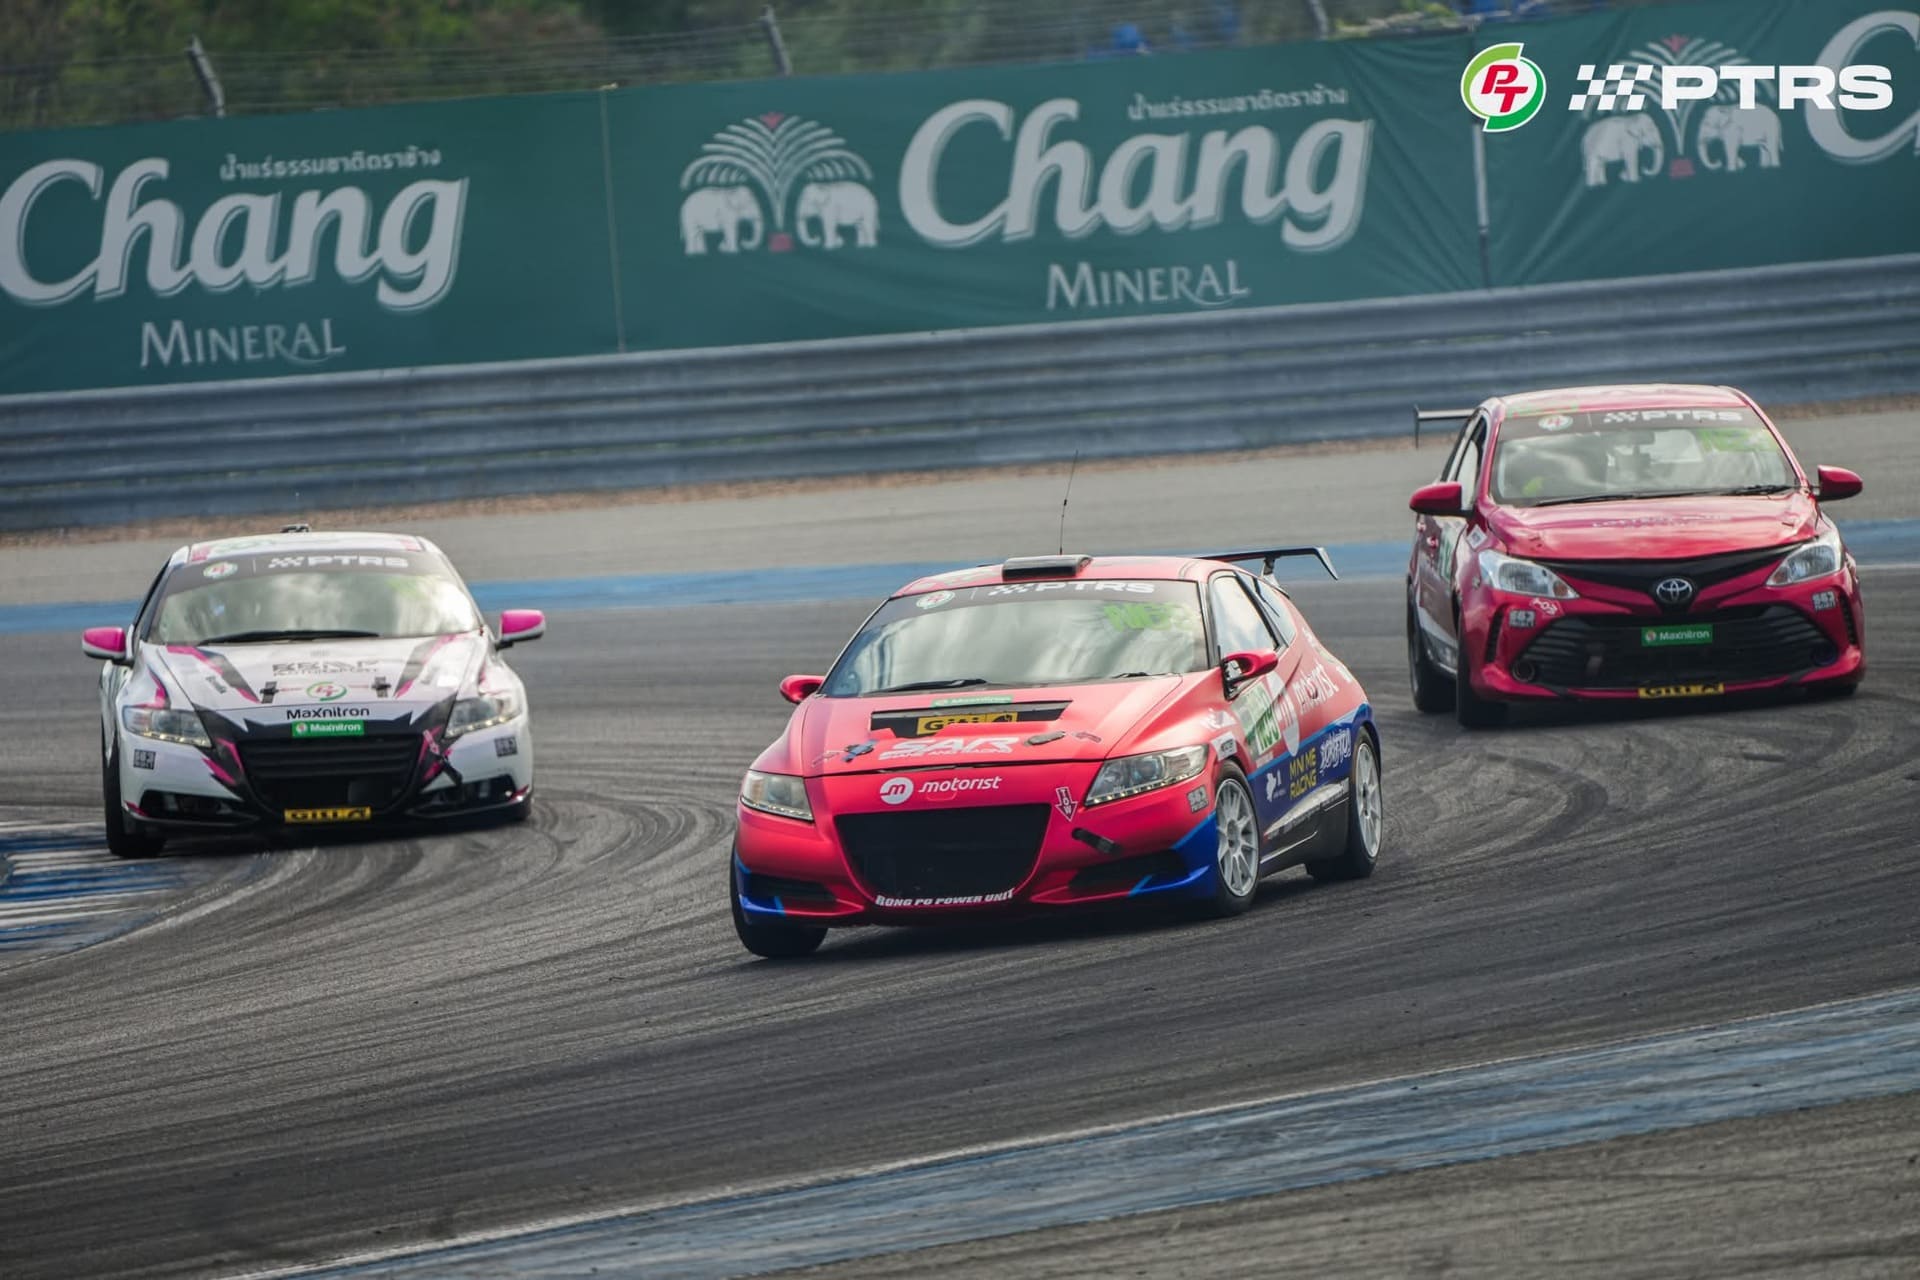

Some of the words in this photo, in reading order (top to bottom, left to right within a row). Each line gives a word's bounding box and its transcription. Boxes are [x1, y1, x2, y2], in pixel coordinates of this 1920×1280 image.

[899, 98, 1374, 252] Chang
[0, 157, 470, 312] Chang
[1642, 410, 1743, 422] PTRS
[308, 555, 408, 568] PTRS
[1036, 582, 1155, 594] PTRS
[1660, 630, 1709, 641] Maxnitron
[310, 723, 361, 732] Maxnitron
[918, 776, 1002, 793] motorist
[1290, 769, 1317, 799] RACING
[1060, 789, 1072, 815] TOW
[935, 896, 983, 905] POWER
[984, 887, 1015, 902] UNIT
